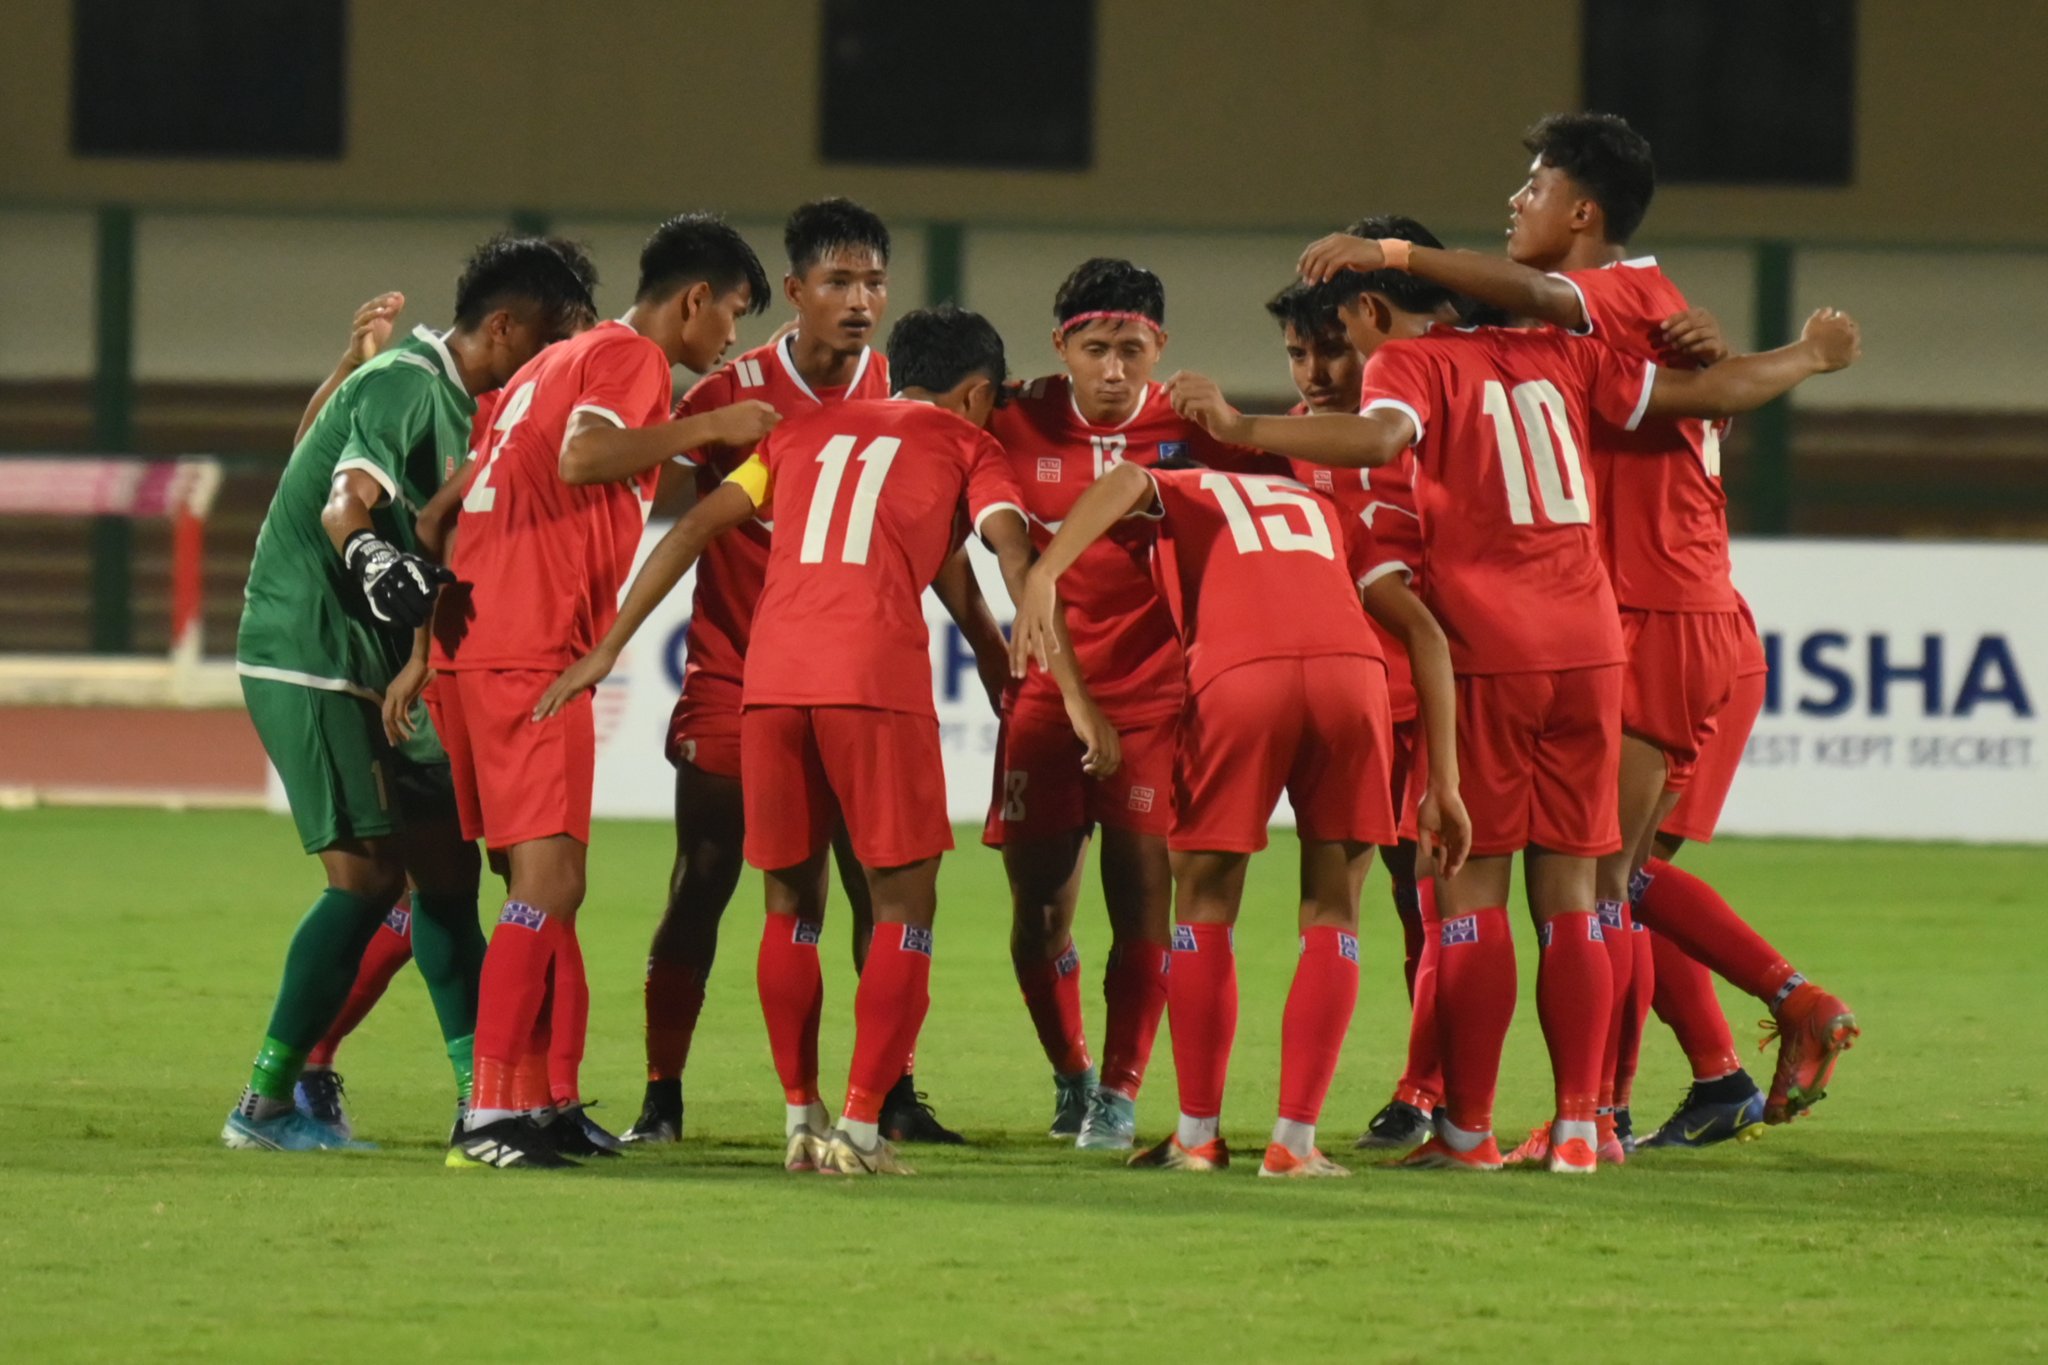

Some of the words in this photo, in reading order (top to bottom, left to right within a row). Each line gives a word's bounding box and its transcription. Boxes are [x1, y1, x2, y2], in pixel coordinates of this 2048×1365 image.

[1090, 433, 1127, 480] 13
[1482, 380, 1590, 524] 10
[800, 434, 902, 565] 11
[1200, 473, 1335, 560] 15
[1763, 631, 2034, 717] ISHA
